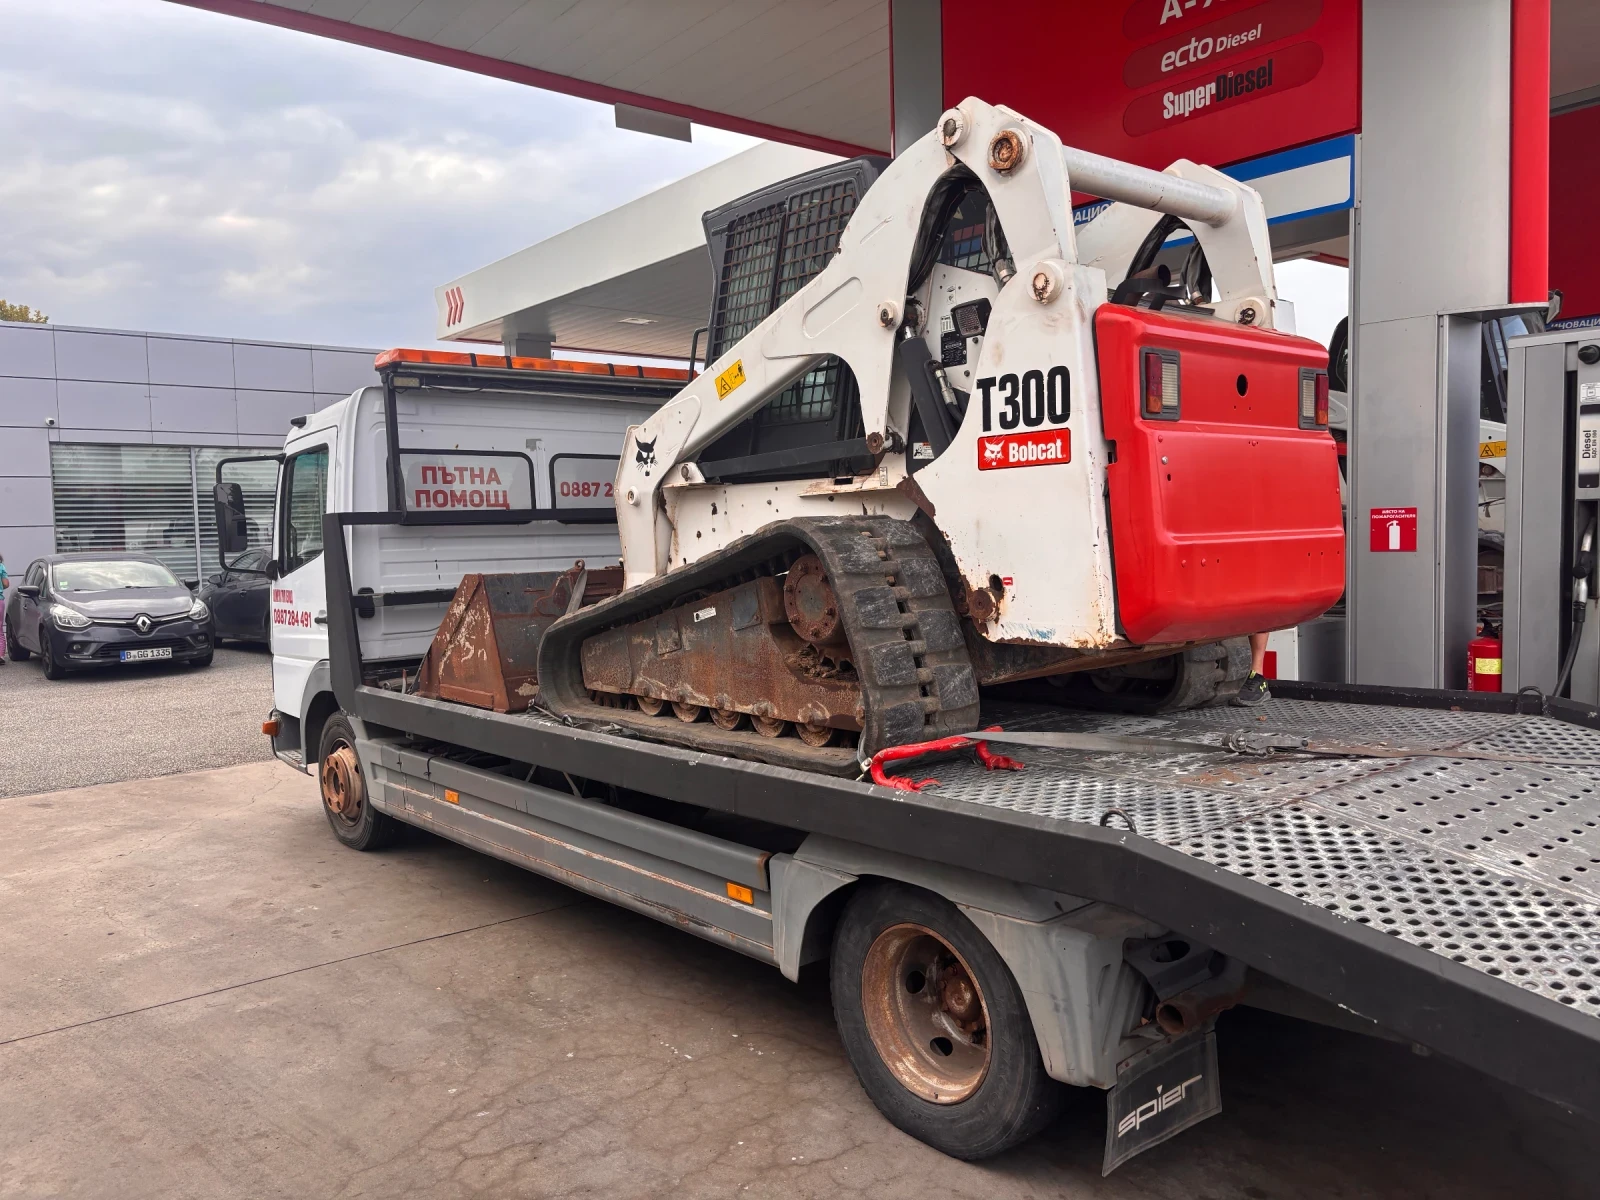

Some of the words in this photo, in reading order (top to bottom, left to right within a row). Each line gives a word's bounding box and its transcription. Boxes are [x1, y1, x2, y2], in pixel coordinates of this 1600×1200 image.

[1161, 37, 1213, 72] ecto
[1216, 24, 1262, 53] Diesel
[1163, 59, 1273, 119] SuperDiesel
[977, 366, 1071, 432] T300
[1008, 438, 1063, 463] Bobcat
[1582, 430, 1591, 459] Diesel
[421, 466, 502, 486] ПЪТНА
[415, 489, 511, 511] ПОМОЩ
[560, 481, 601, 498] 0887
[274, 608, 287, 625] 0887
[287, 609, 299, 626] 284
[300, 611, 311, 628] 491
[126, 651, 132, 659] B
[137, 650, 148, 659] GG
[150, 648, 171, 657] 1335
[1118, 1074, 1203, 1138] spier
